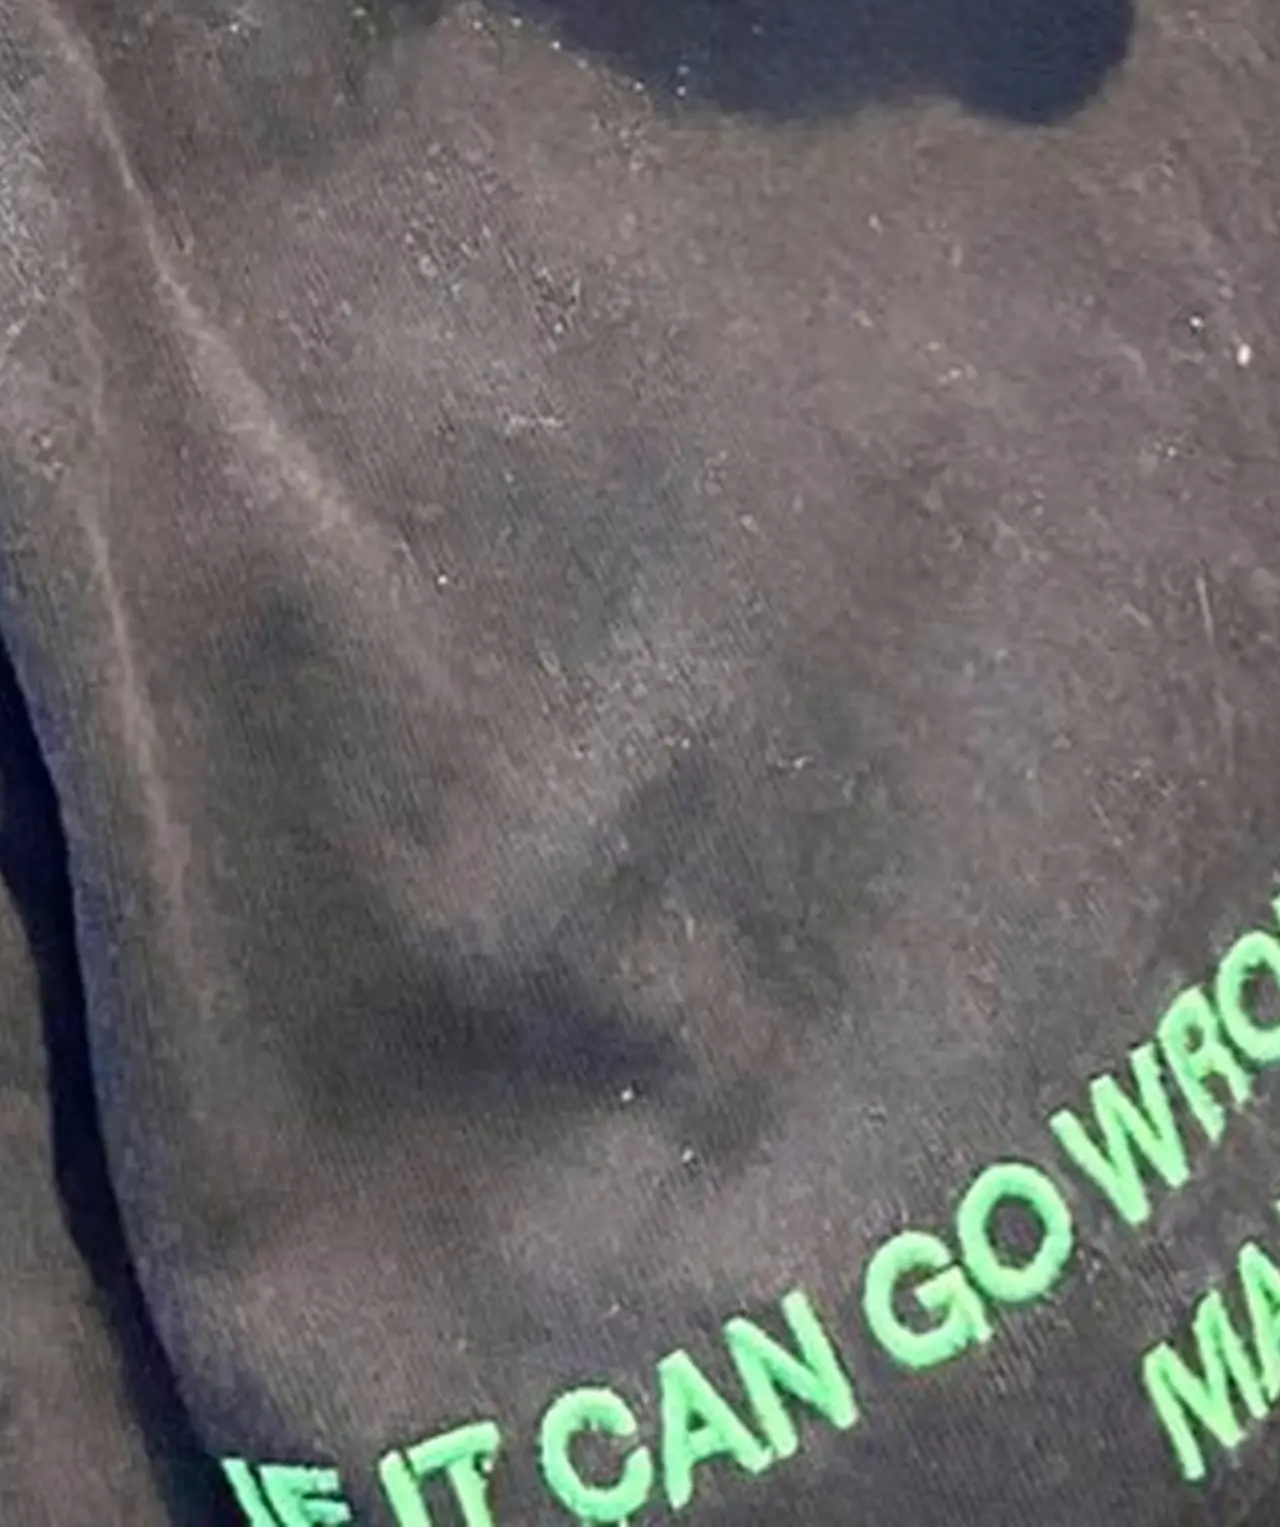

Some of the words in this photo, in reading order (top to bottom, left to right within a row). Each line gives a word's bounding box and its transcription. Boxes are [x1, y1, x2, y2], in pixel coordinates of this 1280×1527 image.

[379, 1423, 501, 1527] IT
[540, 1290, 860, 1522] CAN
[863, 1161, 1074, 1369] GO
